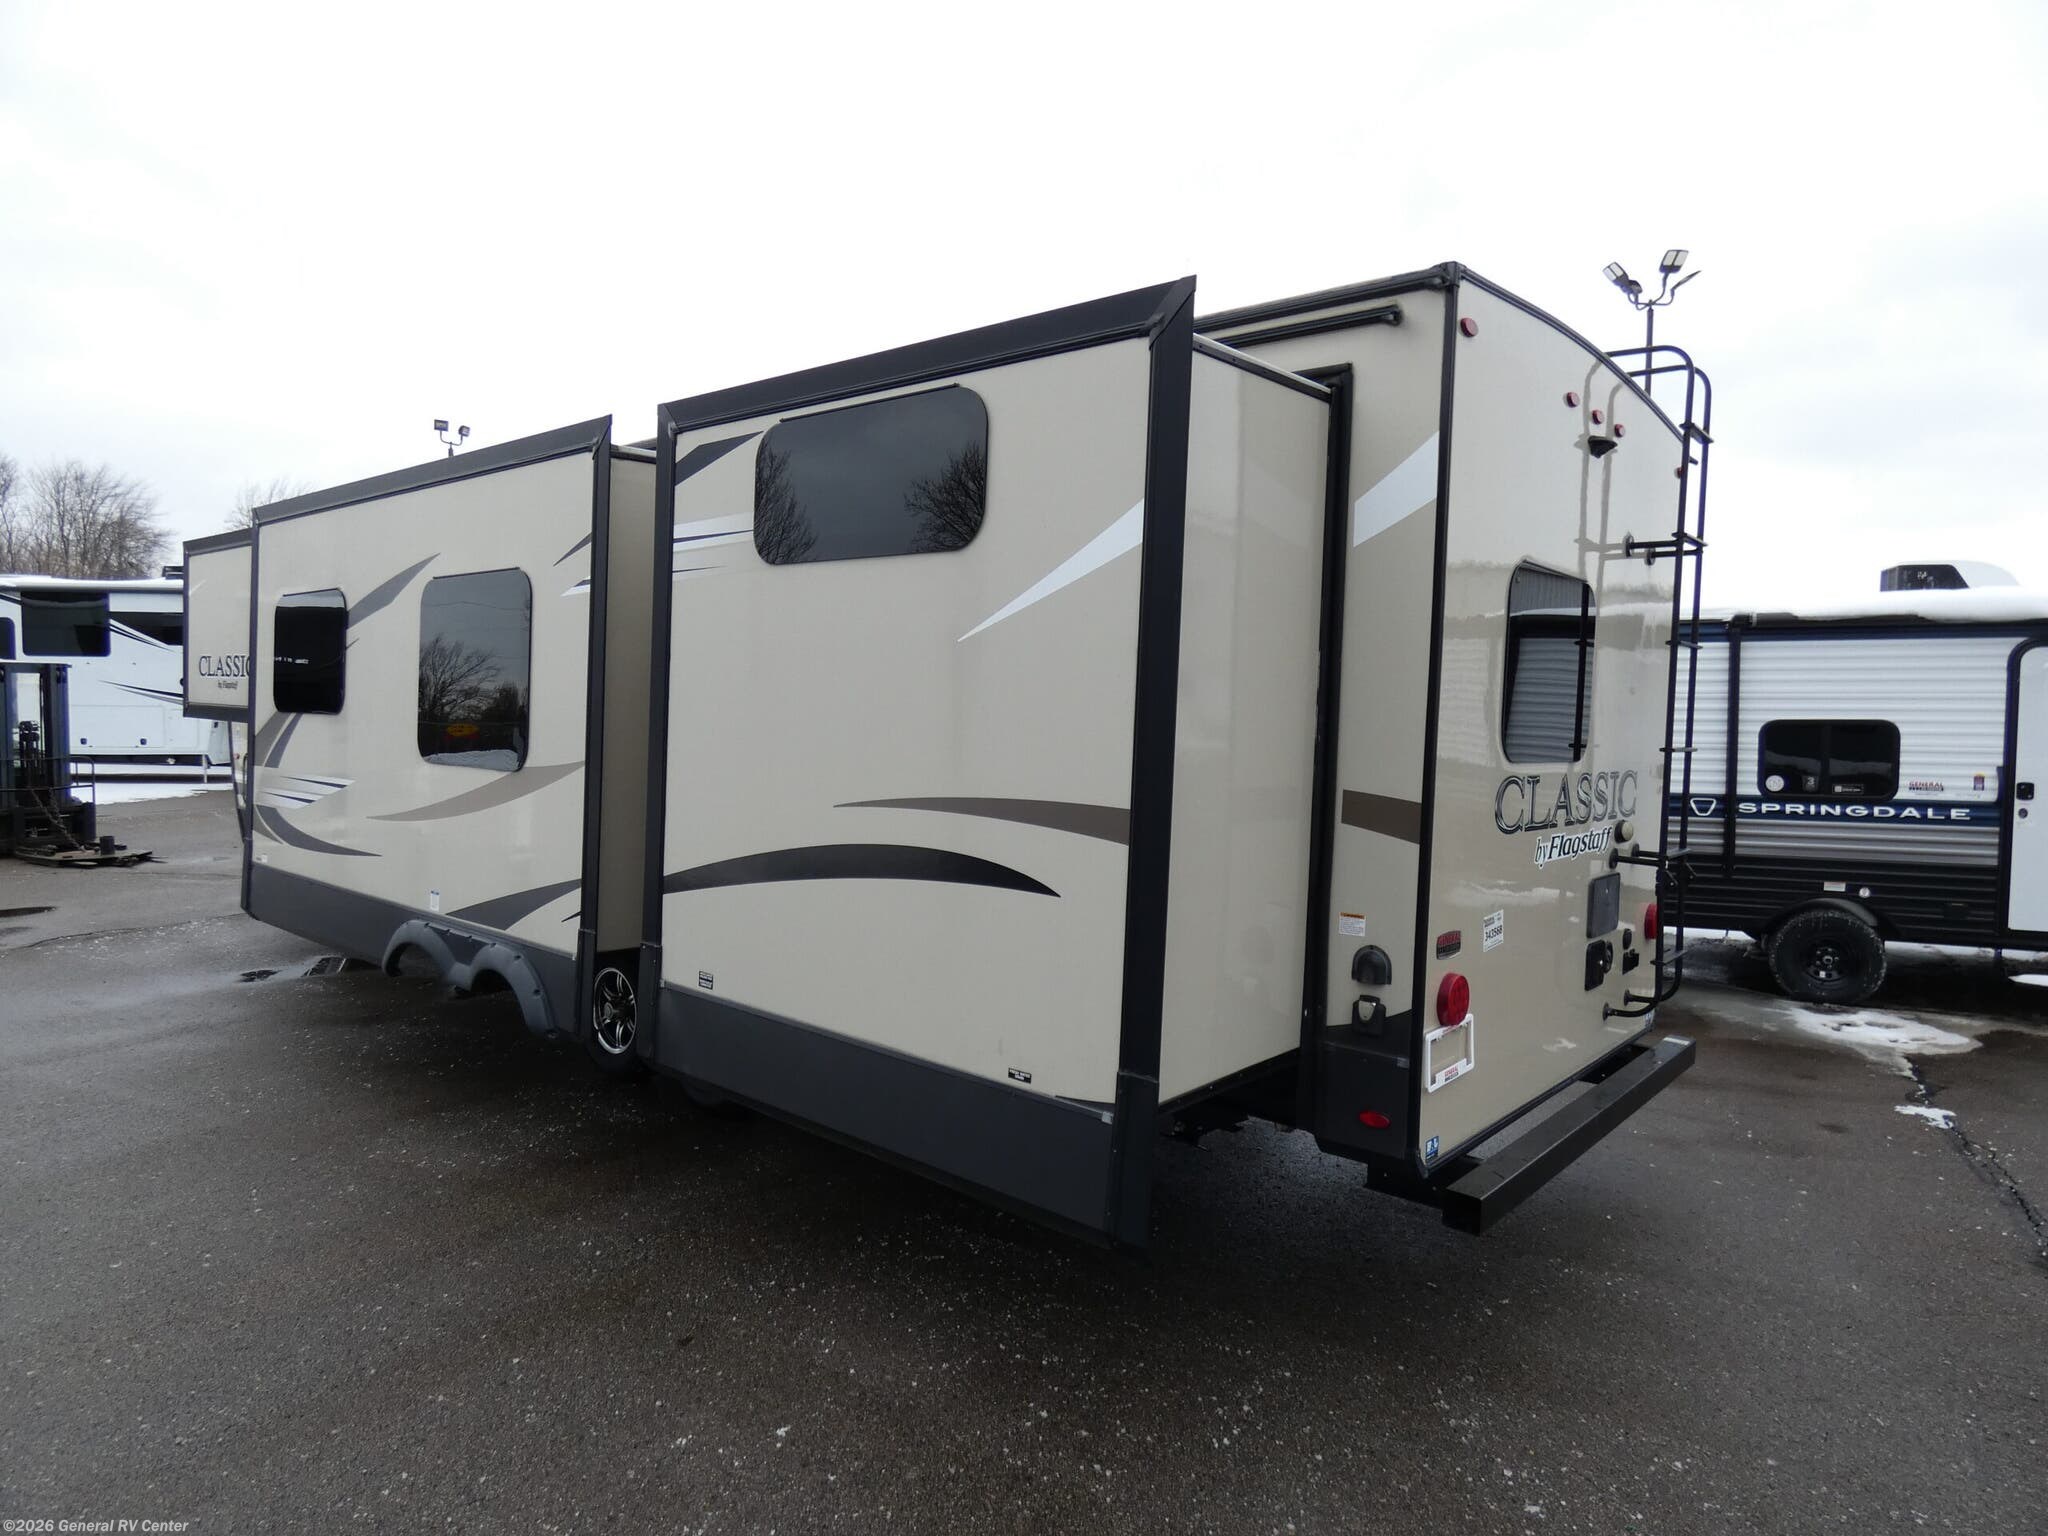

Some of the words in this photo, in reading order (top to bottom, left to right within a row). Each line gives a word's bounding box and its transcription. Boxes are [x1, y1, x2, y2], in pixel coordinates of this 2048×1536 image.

[1495, 770, 1638, 835] CLASSIC
[1738, 802, 1971, 820] SPRINGDALE
[1534, 838, 1549, 868] by
[1547, 826, 1613, 858] Flagstaff
